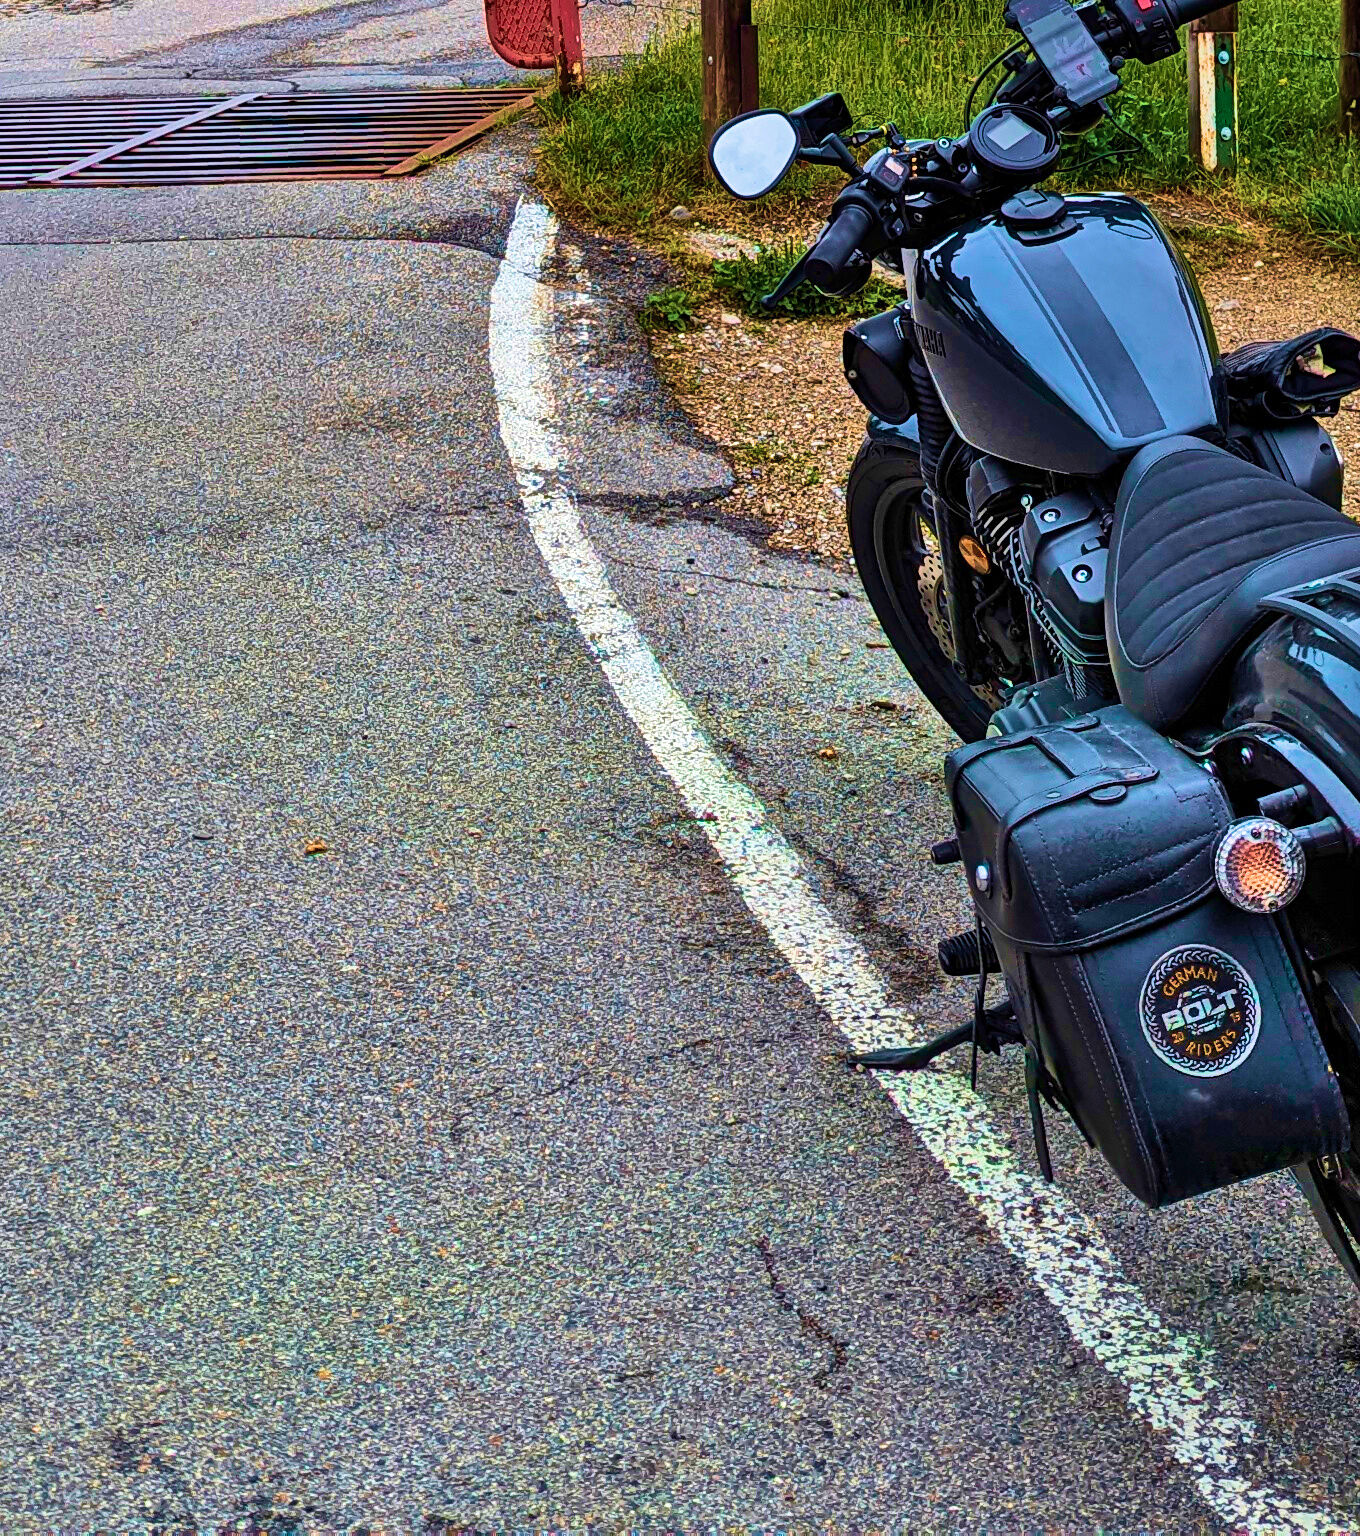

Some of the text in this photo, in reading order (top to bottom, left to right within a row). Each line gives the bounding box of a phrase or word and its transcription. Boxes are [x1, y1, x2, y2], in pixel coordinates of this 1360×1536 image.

[1163, 965, 1218, 996] GERMAN
[1161, 988, 1238, 1032] BOLT
[1185, 1028, 1236, 1057] RIDERS
